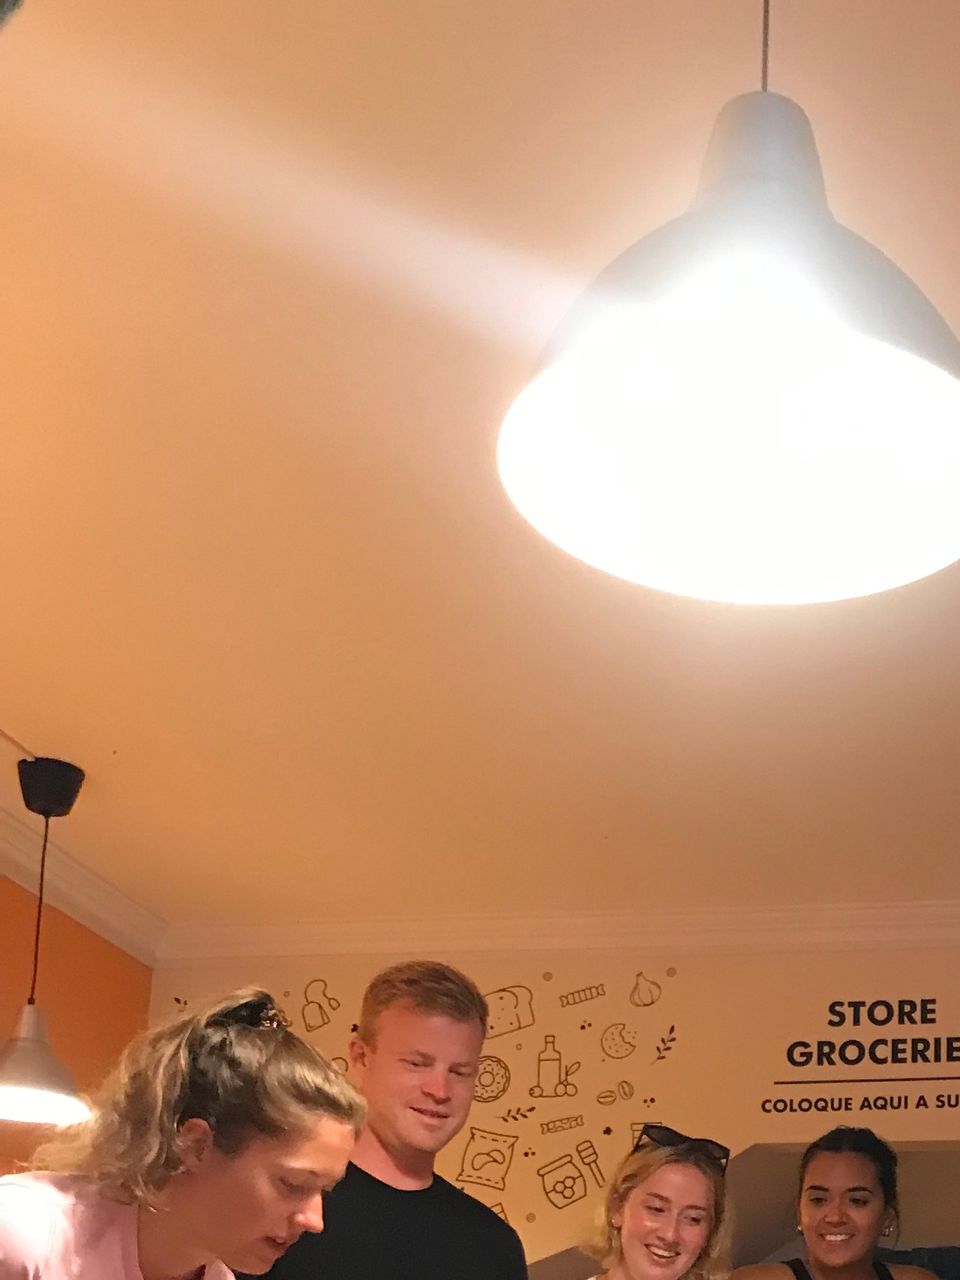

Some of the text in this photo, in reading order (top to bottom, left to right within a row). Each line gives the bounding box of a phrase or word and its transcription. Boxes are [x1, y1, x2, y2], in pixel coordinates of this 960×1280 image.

[827, 998, 937, 1028] STORE
[760, 1096, 854, 1114] COLOQUE
[858, 1094, 909, 1112] AQUI
[914, 1094, 930, 1110] A
